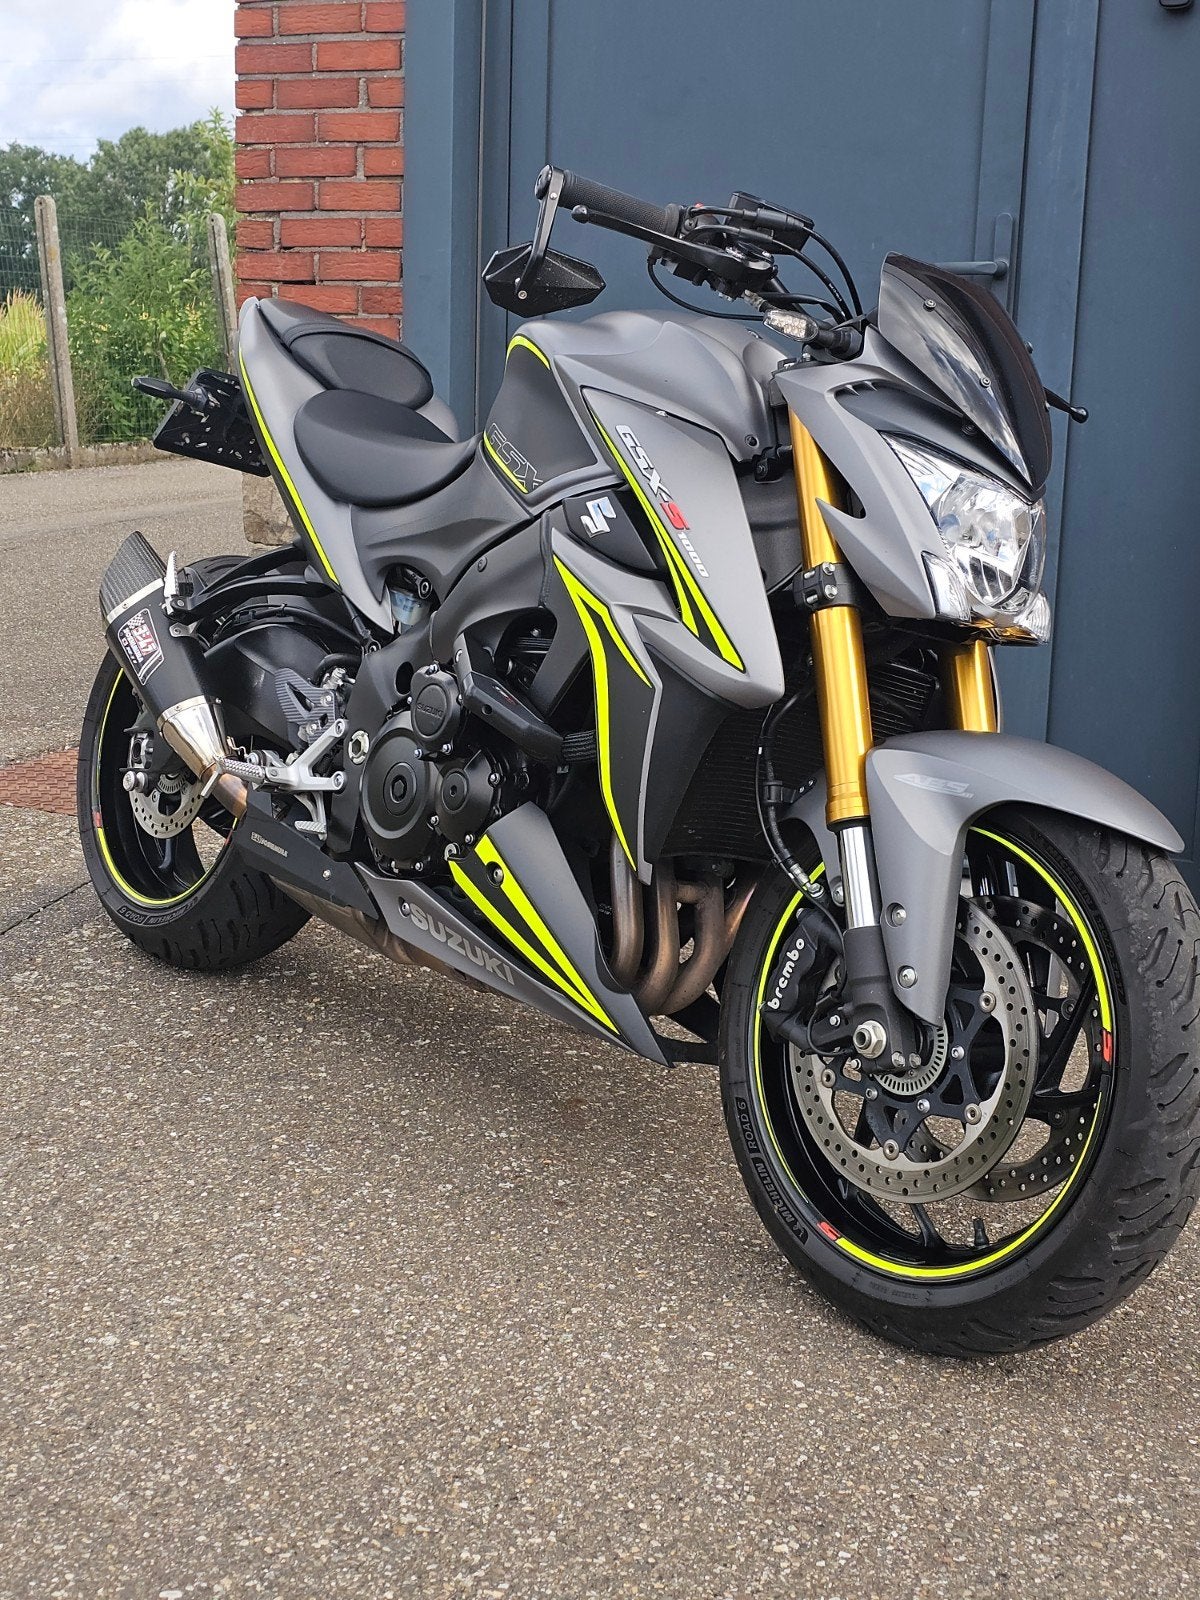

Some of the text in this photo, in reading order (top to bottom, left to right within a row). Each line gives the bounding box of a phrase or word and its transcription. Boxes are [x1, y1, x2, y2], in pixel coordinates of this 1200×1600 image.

[410, 903, 515, 985] SUZUKI
[767, 938, 805, 1010] brembo
[740, 1114, 758, 1150] ROAD
[755, 1162, 795, 1222] MICHELIN
